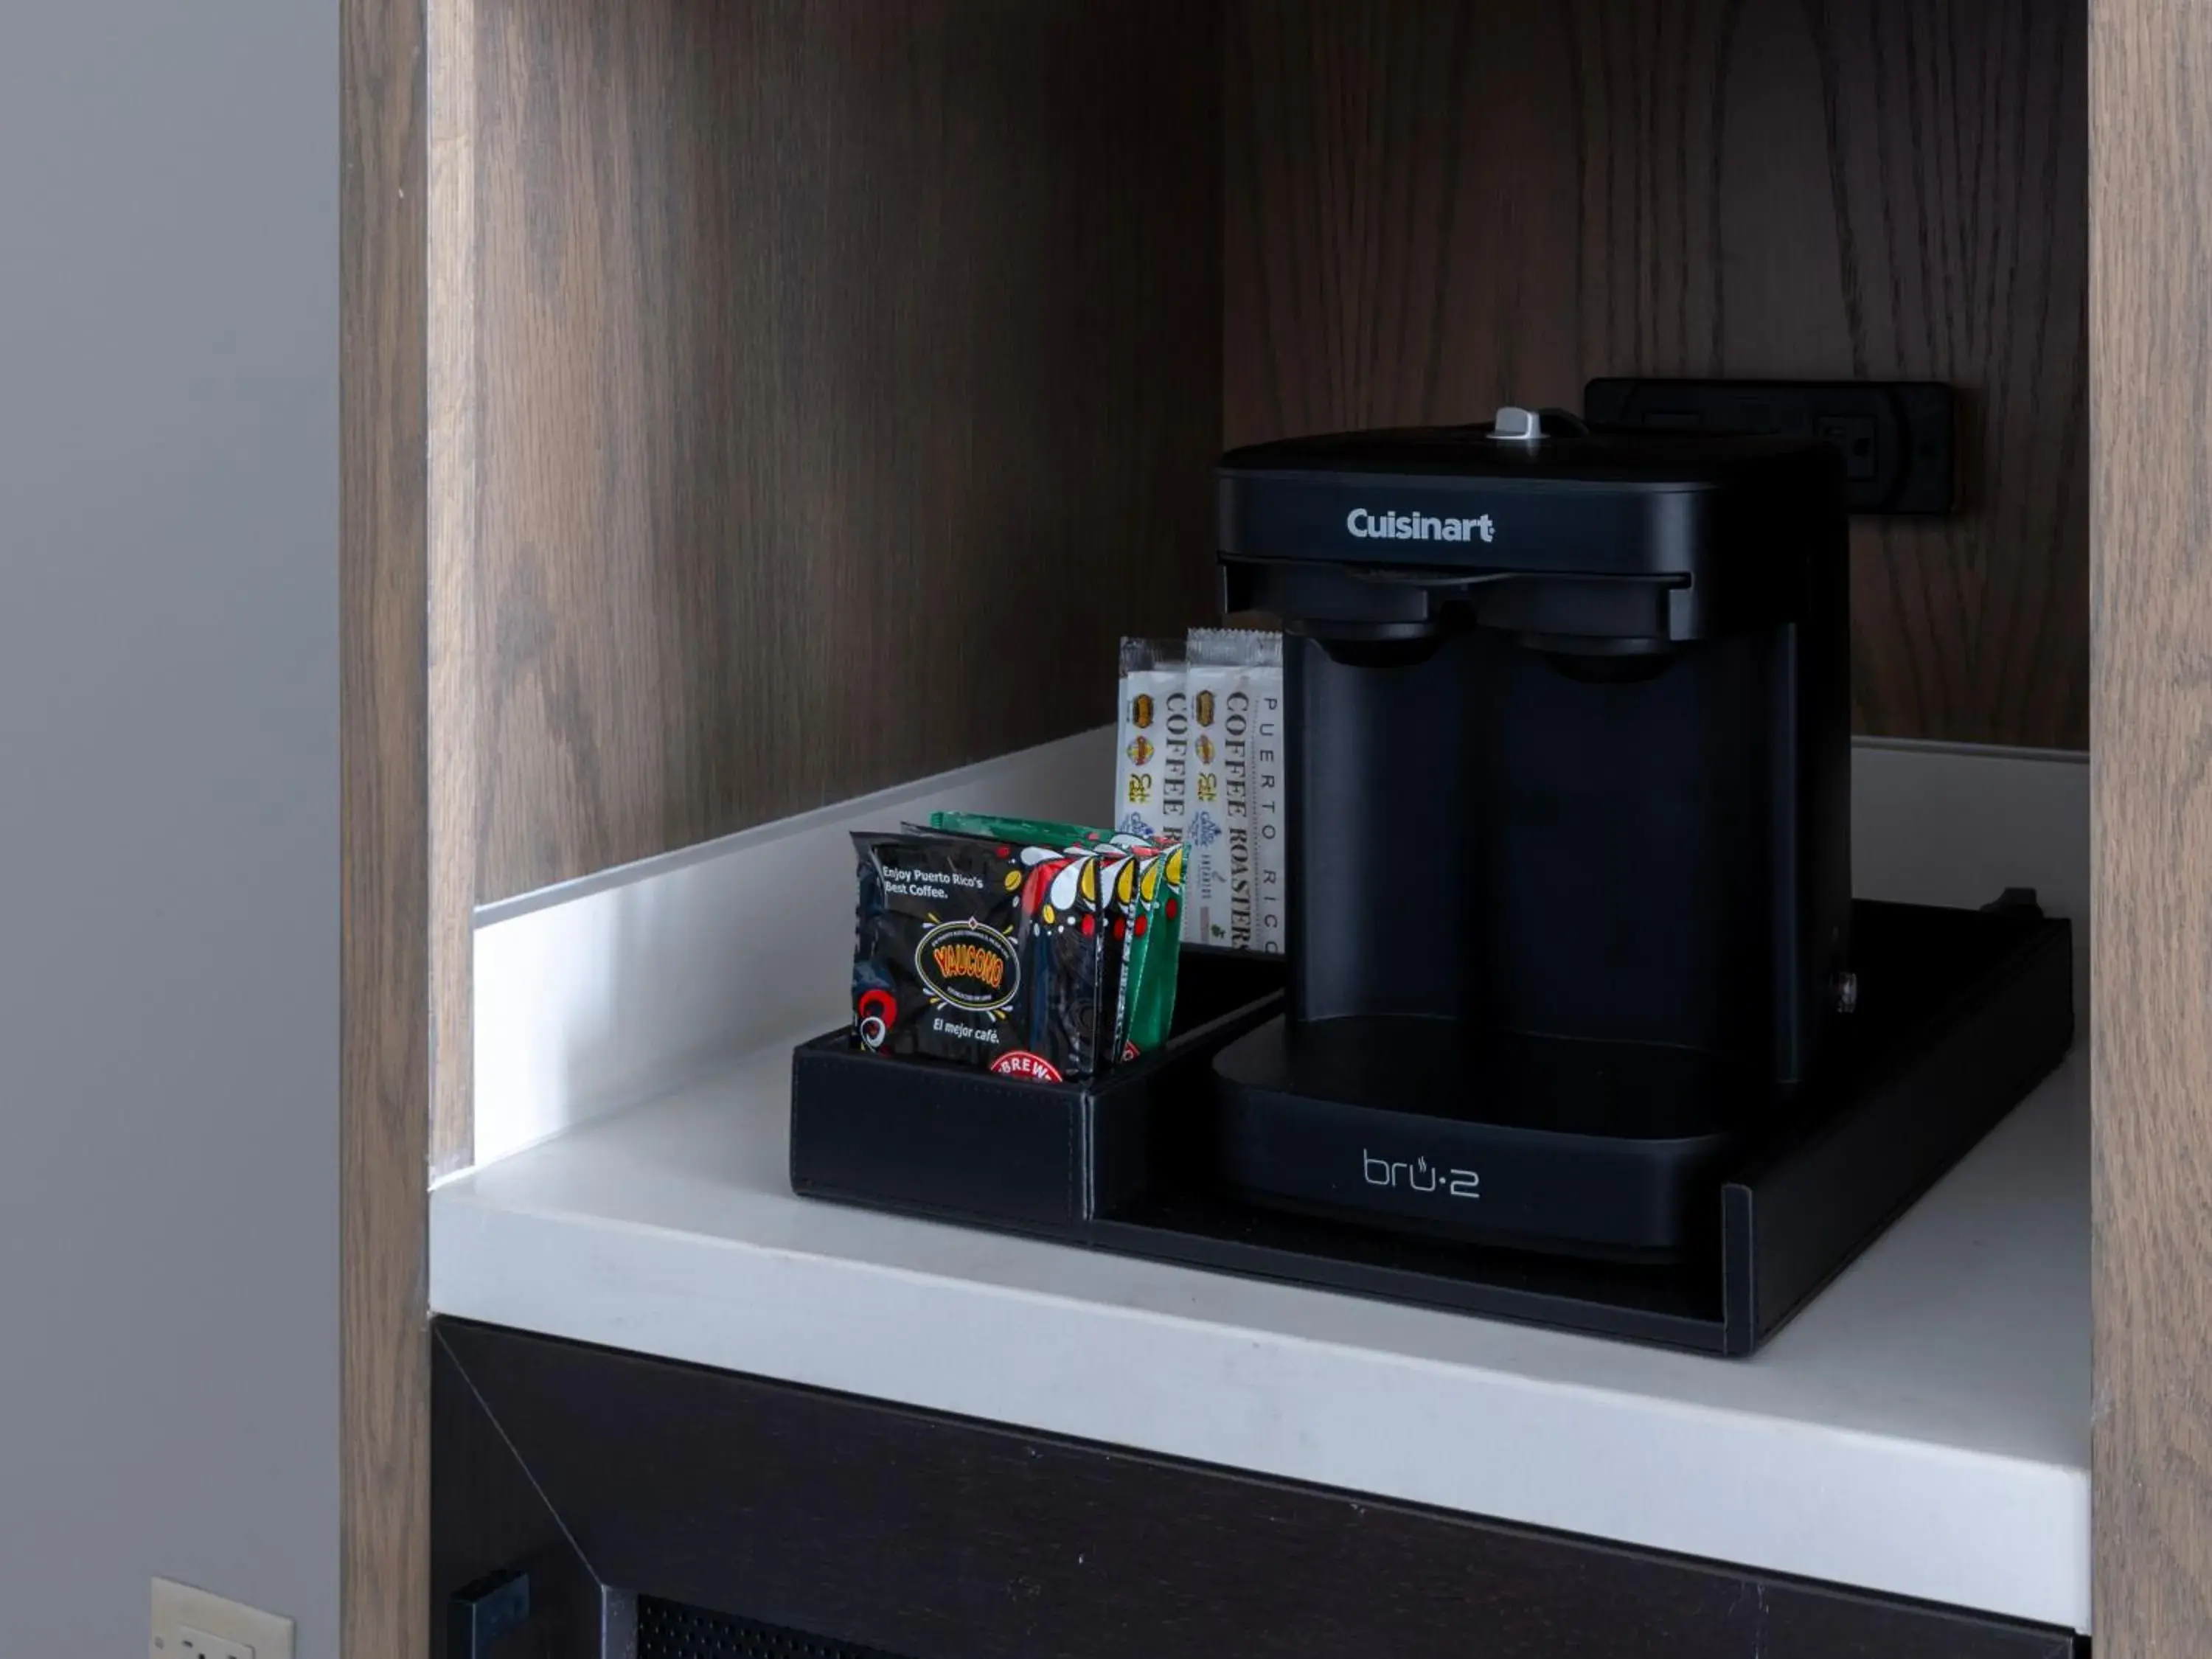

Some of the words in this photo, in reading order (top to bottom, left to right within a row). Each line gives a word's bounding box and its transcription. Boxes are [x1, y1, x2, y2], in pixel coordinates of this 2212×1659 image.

[1347, 508, 1493, 542] Cuisinart
[1162, 692, 1188, 815] COFFEE
[1225, 692, 1250, 817] COFFEE
[1259, 697, 1278, 840] PUERTO
[883, 866, 911, 883] Enjoy
[914, 869, 950, 884] Puerto
[952, 873, 984, 889] Rico's
[885, 880, 908, 894] Best
[909, 884, 948, 899] Coffee.
[933, 1018, 944, 1031] El
[945, 1022, 973, 1038] mejor
[974, 1029, 1000, 1044] café.
